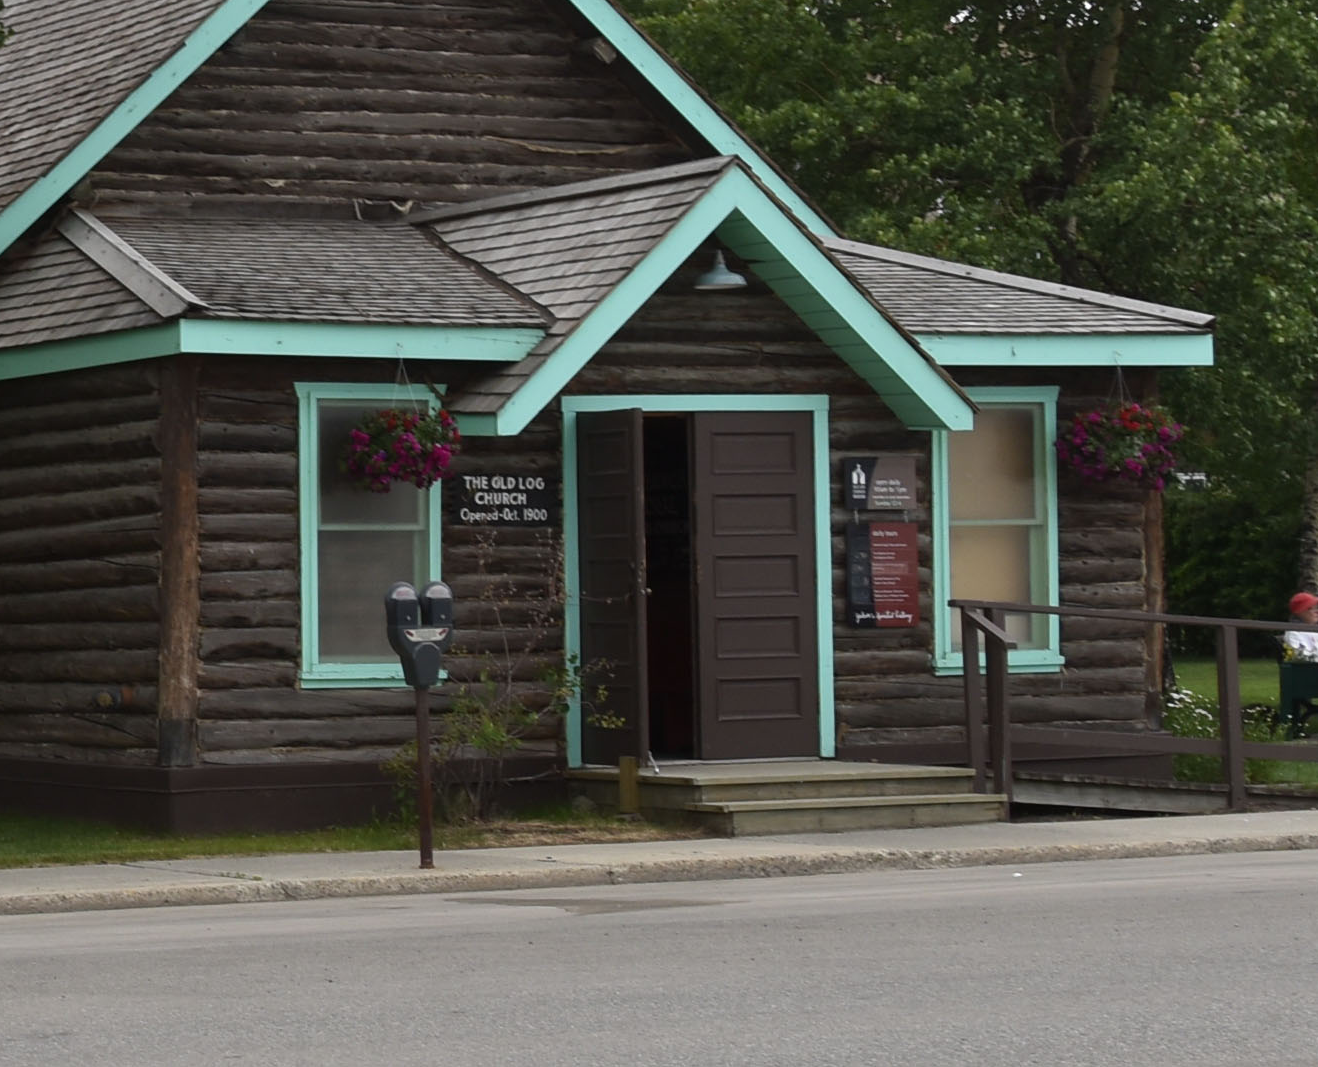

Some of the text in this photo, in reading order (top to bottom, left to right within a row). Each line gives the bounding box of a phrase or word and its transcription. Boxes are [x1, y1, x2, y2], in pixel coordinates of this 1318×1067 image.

[462, 476, 545, 490] THE OLD LOG
[474, 492, 527, 505] CHURCH
[523, 508, 548, 521] 1900
